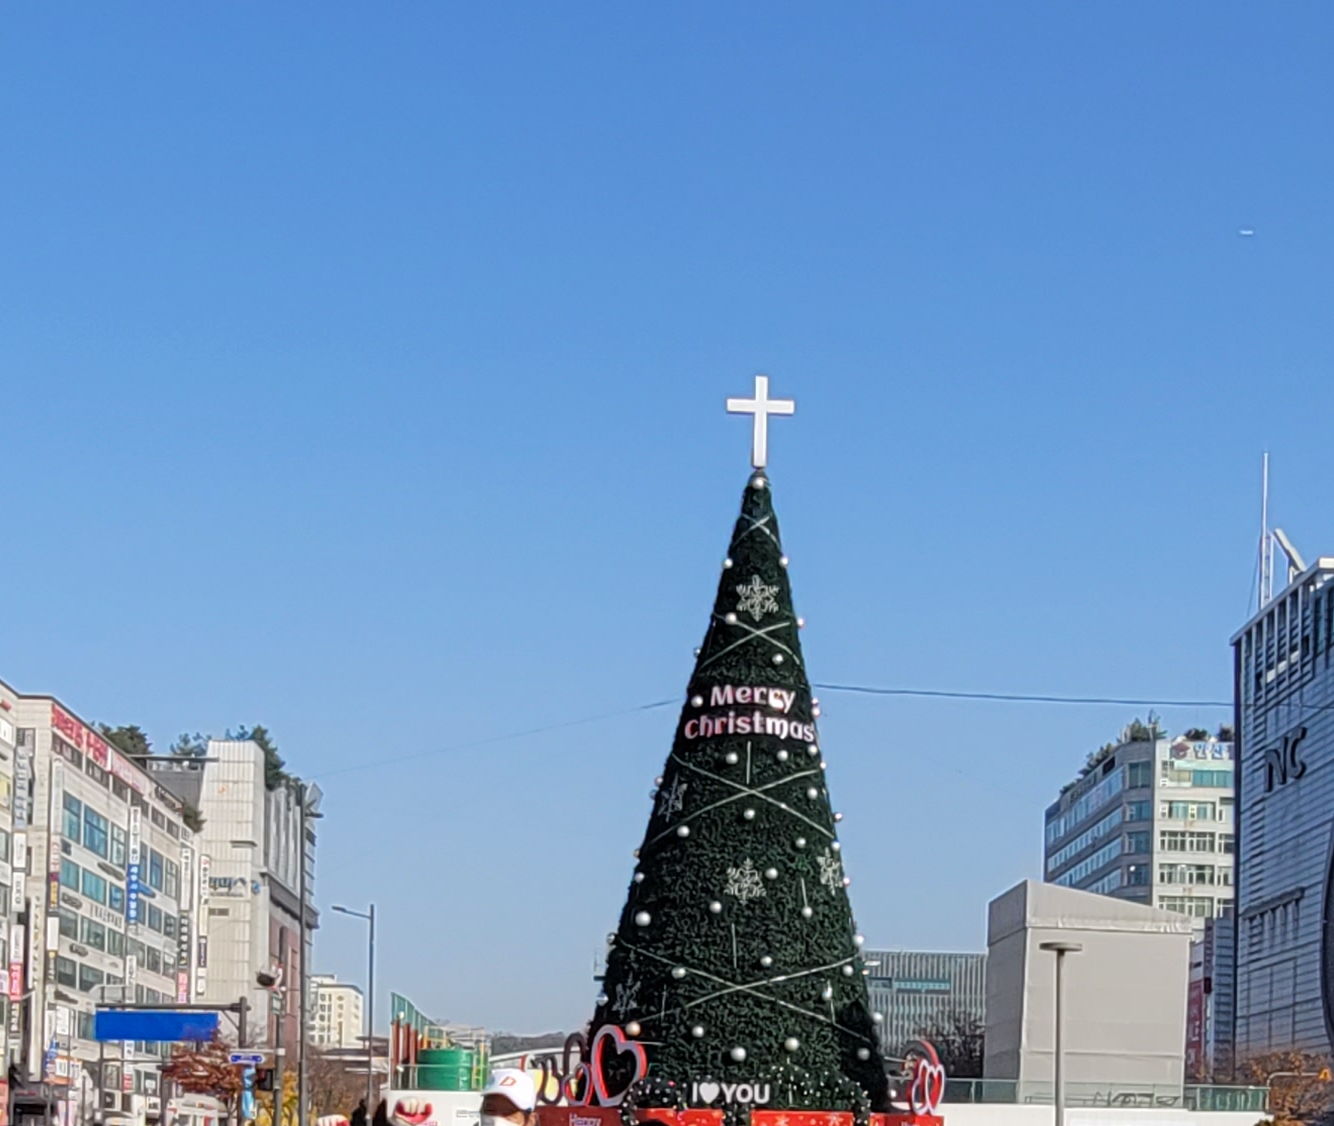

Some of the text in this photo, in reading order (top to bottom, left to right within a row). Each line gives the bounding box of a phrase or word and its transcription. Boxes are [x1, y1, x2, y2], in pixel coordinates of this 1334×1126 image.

[710, 684, 796, 713] Merry
[1264, 726, 1308, 793] NC
[721, 1083, 770, 1103] YOU
